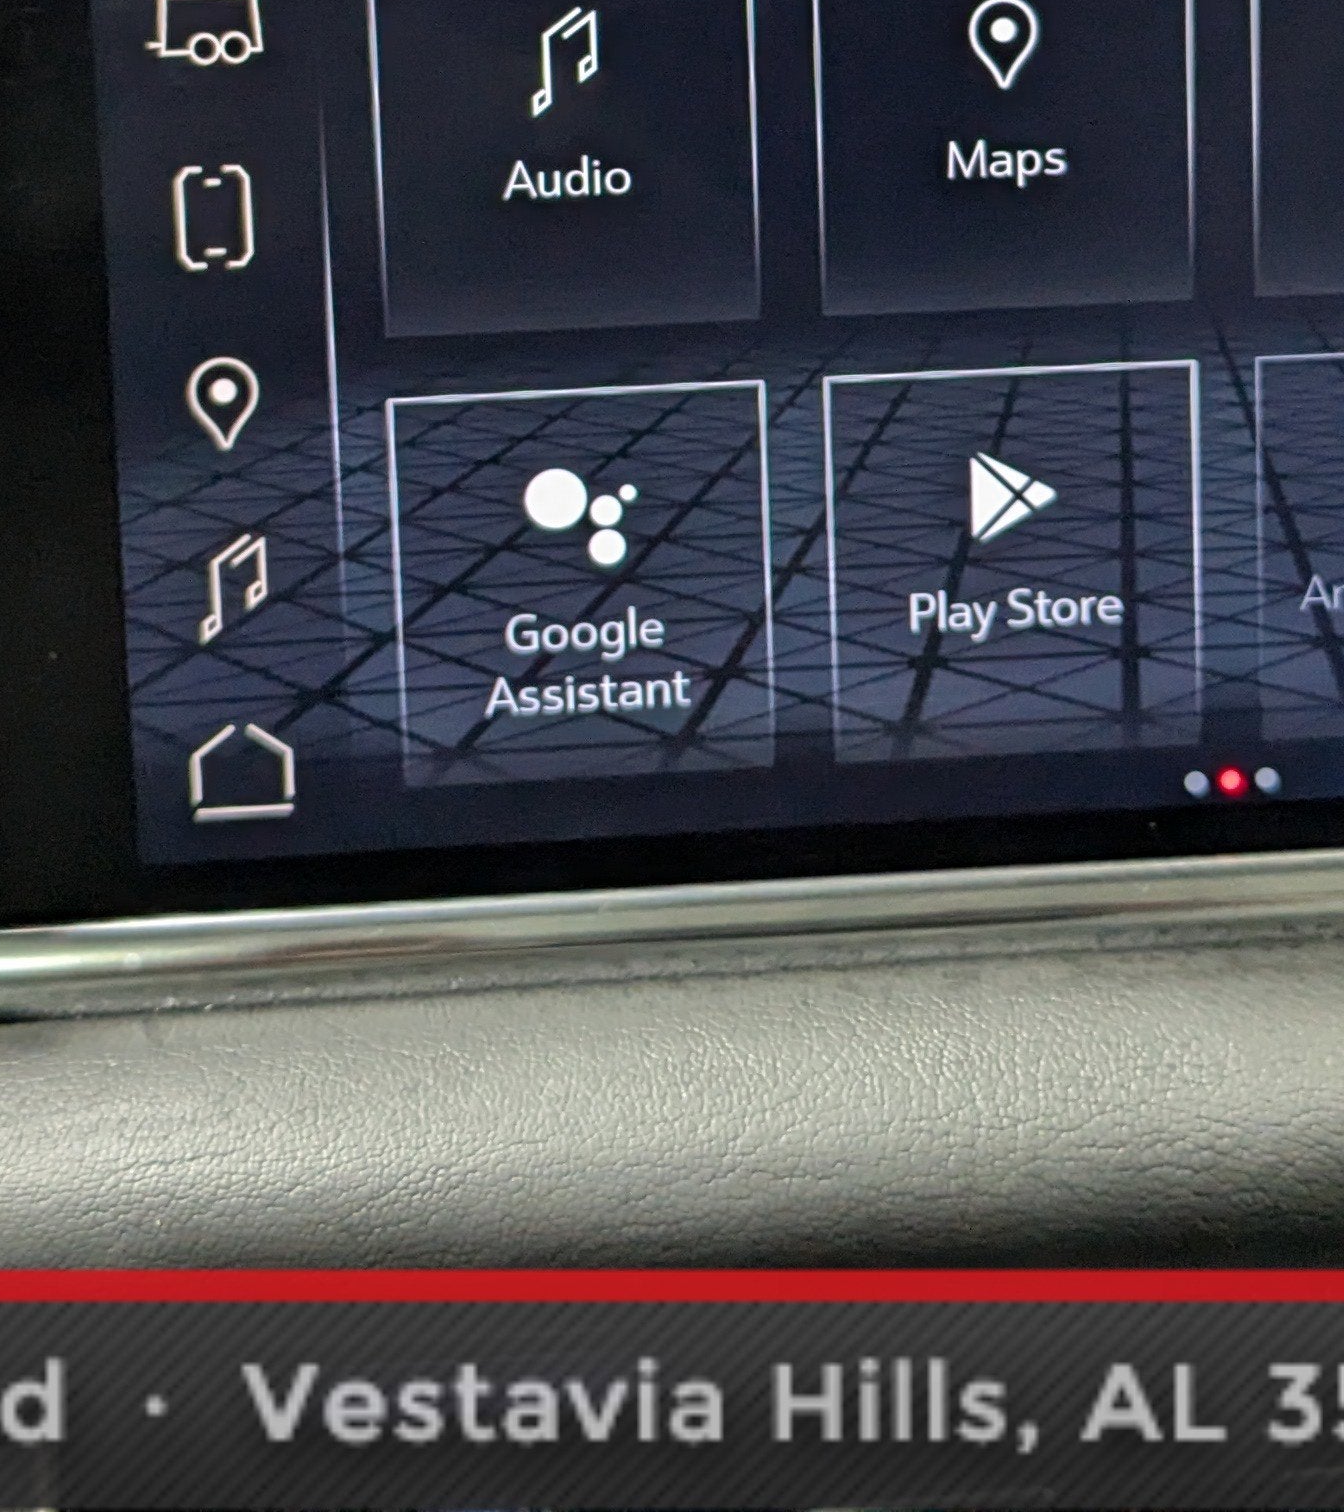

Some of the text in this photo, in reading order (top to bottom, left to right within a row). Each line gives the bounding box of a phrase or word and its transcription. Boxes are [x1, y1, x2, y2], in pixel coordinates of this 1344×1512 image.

[502, 153, 634, 201] Audio
[945, 137, 1069, 189] Maps
[504, 602, 666, 661] Google
[907, 585, 1125, 644] Play Store
[483, 667, 693, 719] Assistant
